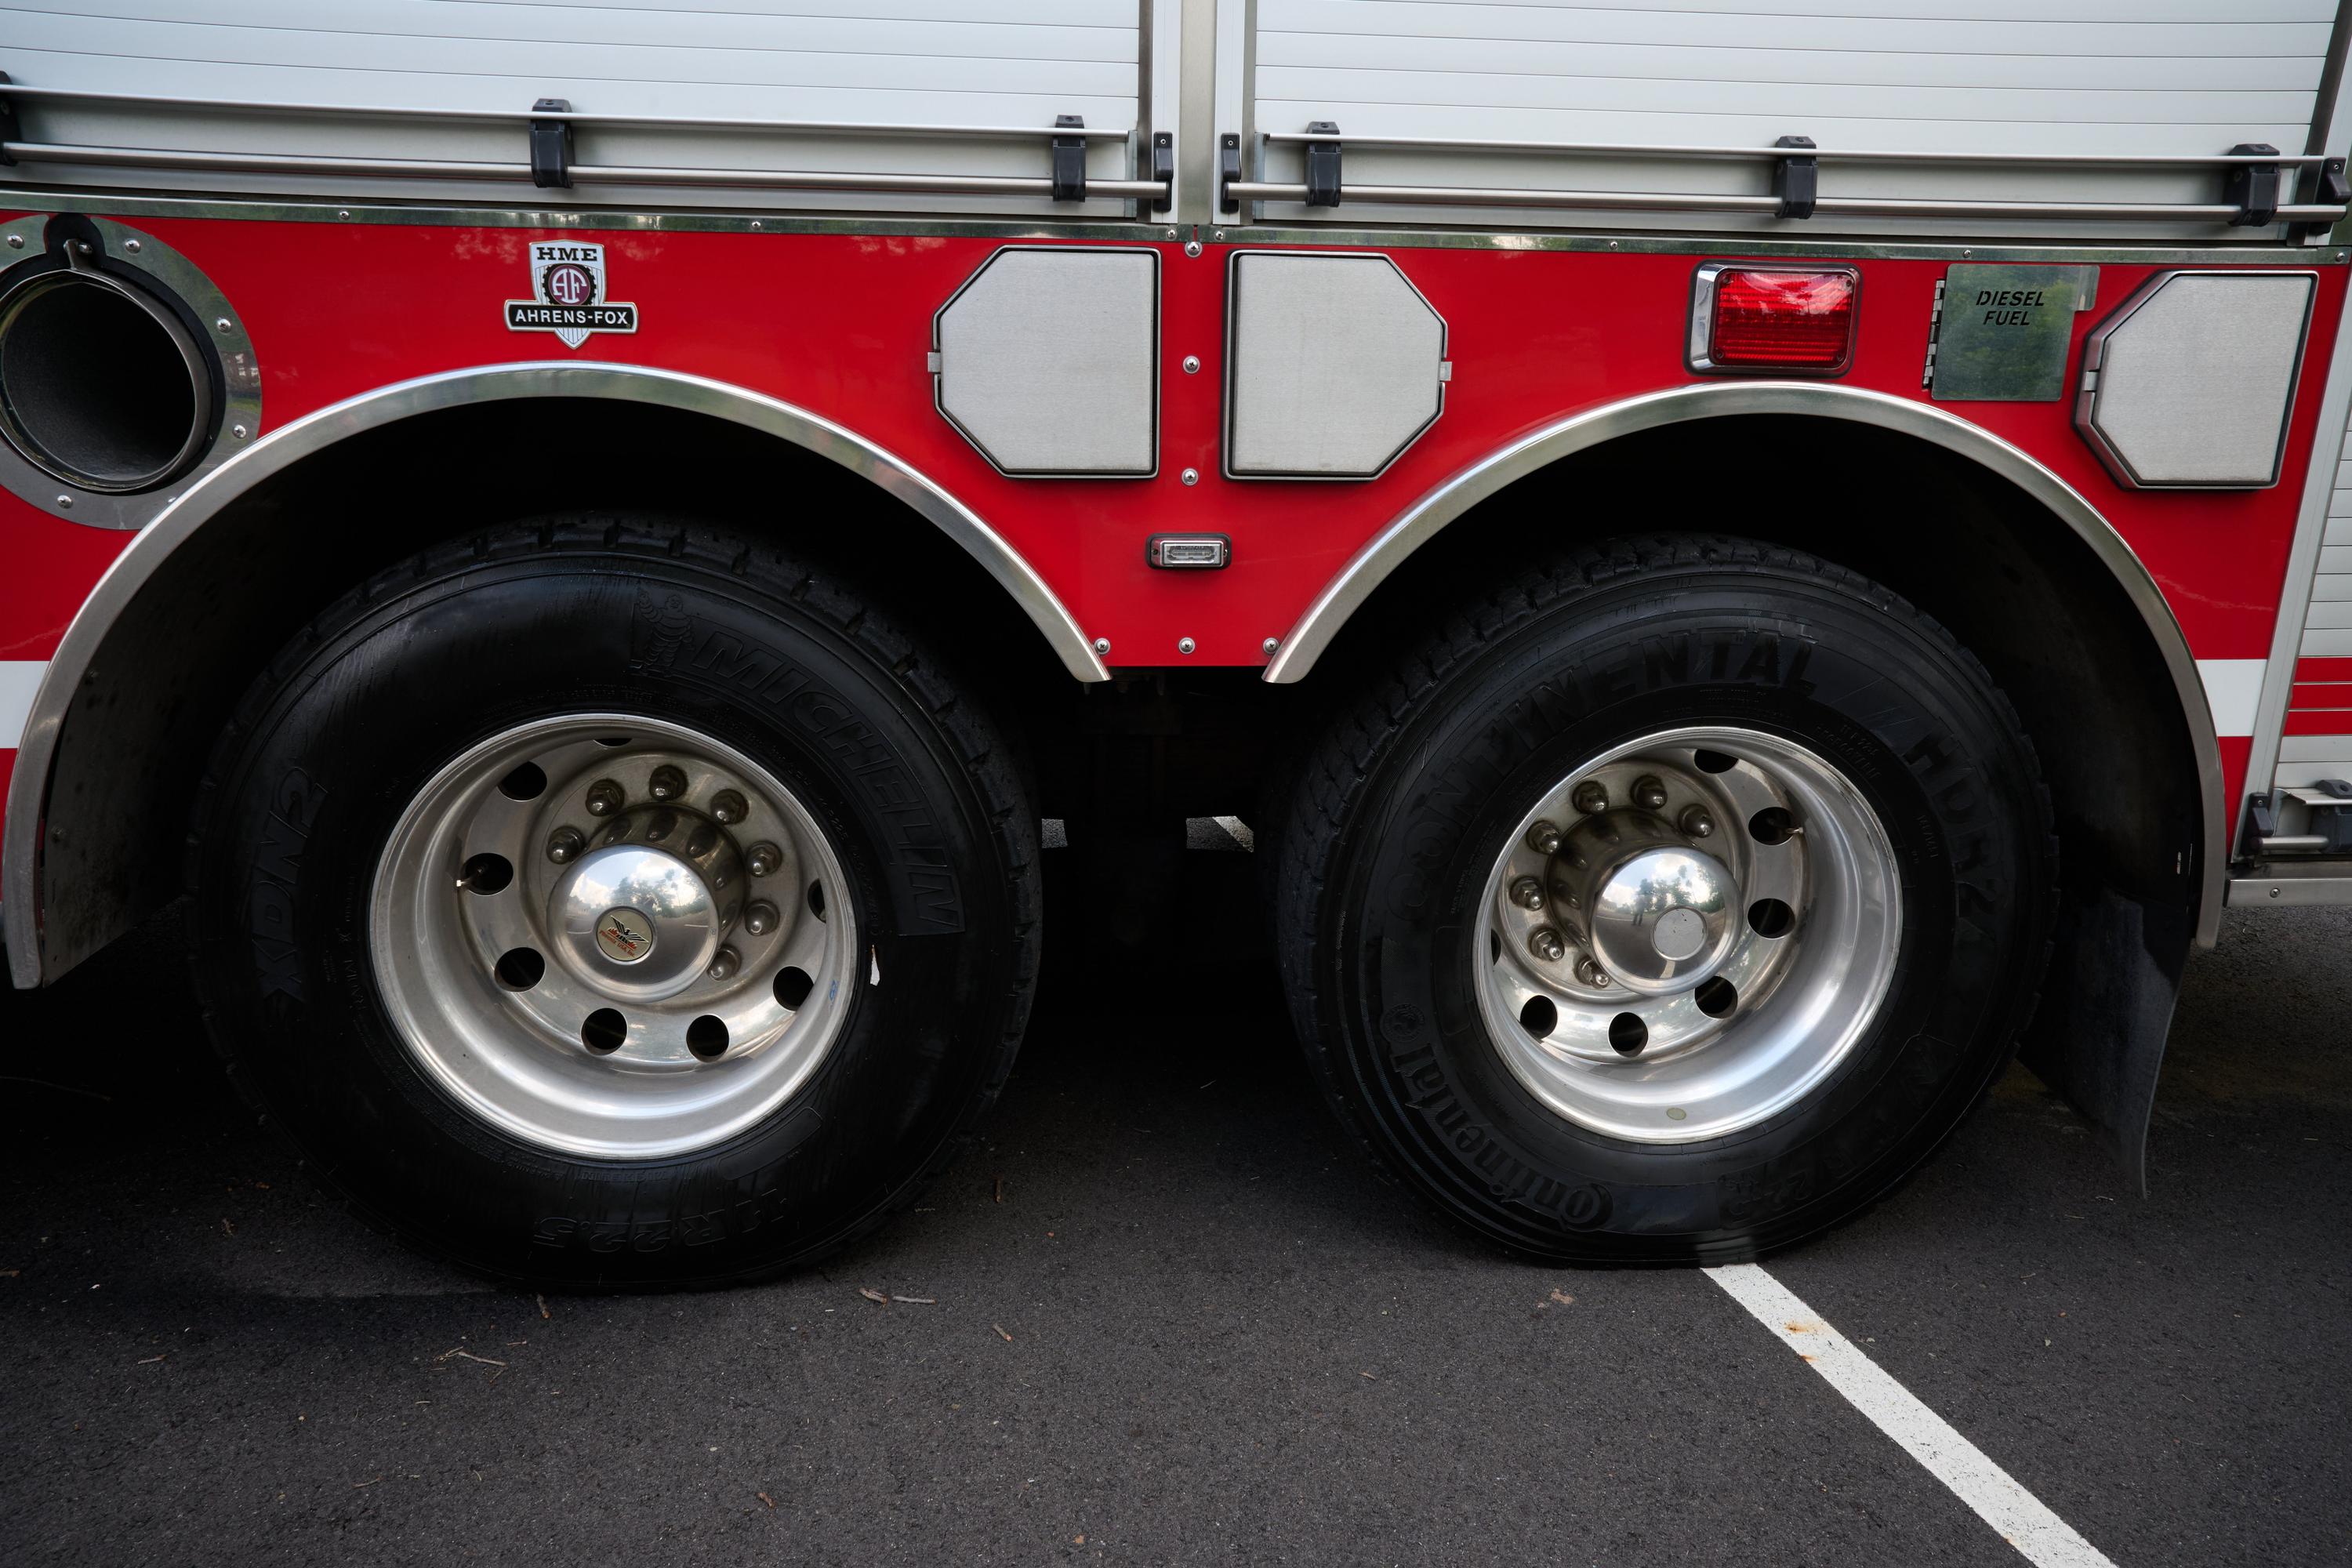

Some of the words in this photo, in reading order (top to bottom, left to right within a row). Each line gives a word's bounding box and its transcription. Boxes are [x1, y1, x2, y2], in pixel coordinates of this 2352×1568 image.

[536, 247, 597, 261] HME
[1976, 291, 2045, 307] DIESEL
[515, 309, 629, 325] AHRENS-FOX
[1983, 311, 2031, 326] FUEL
[693, 630, 961, 933] MICHELIN
[1385, 626, 1817, 920] CONTINENTAL
[250, 766, 332, 1004] XDN2
[1389, 1044, 1613, 1232] Continental
